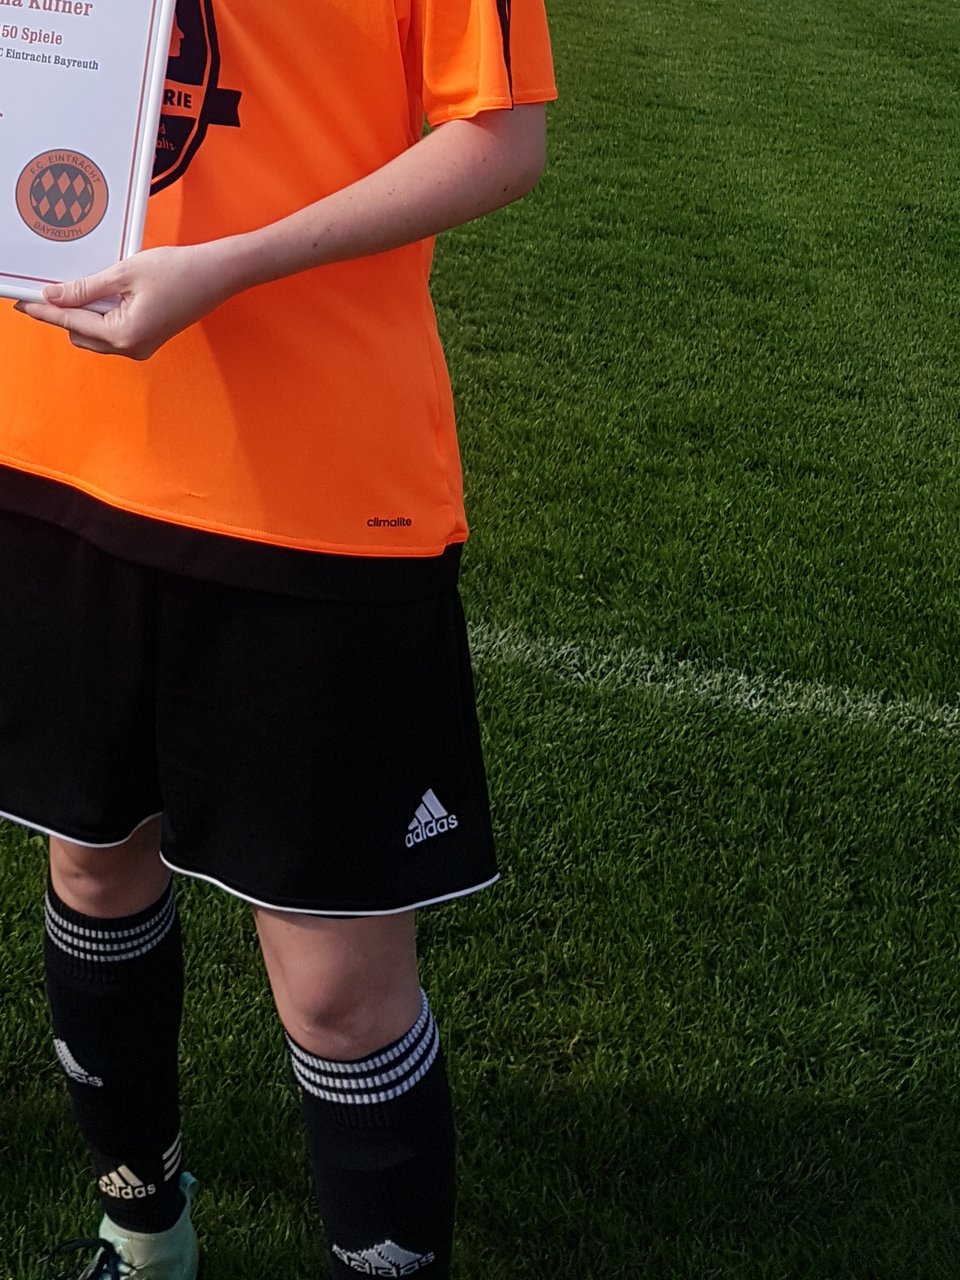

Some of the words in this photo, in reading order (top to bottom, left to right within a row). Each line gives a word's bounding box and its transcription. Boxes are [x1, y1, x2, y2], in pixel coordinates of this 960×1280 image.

[21, 27, 63, 45] Spiele
[5, 48, 51, 64] Eintracht
[53, 55, 99, 70] Bayreuth
[48, 154, 101, 183] EINTRACHT
[33, 221, 83, 238] BAYREUTH
[367, 517, 412, 527] climalite
[405, 814, 458, 848] adidas
[98, 1178, 156, 1199] adidas
